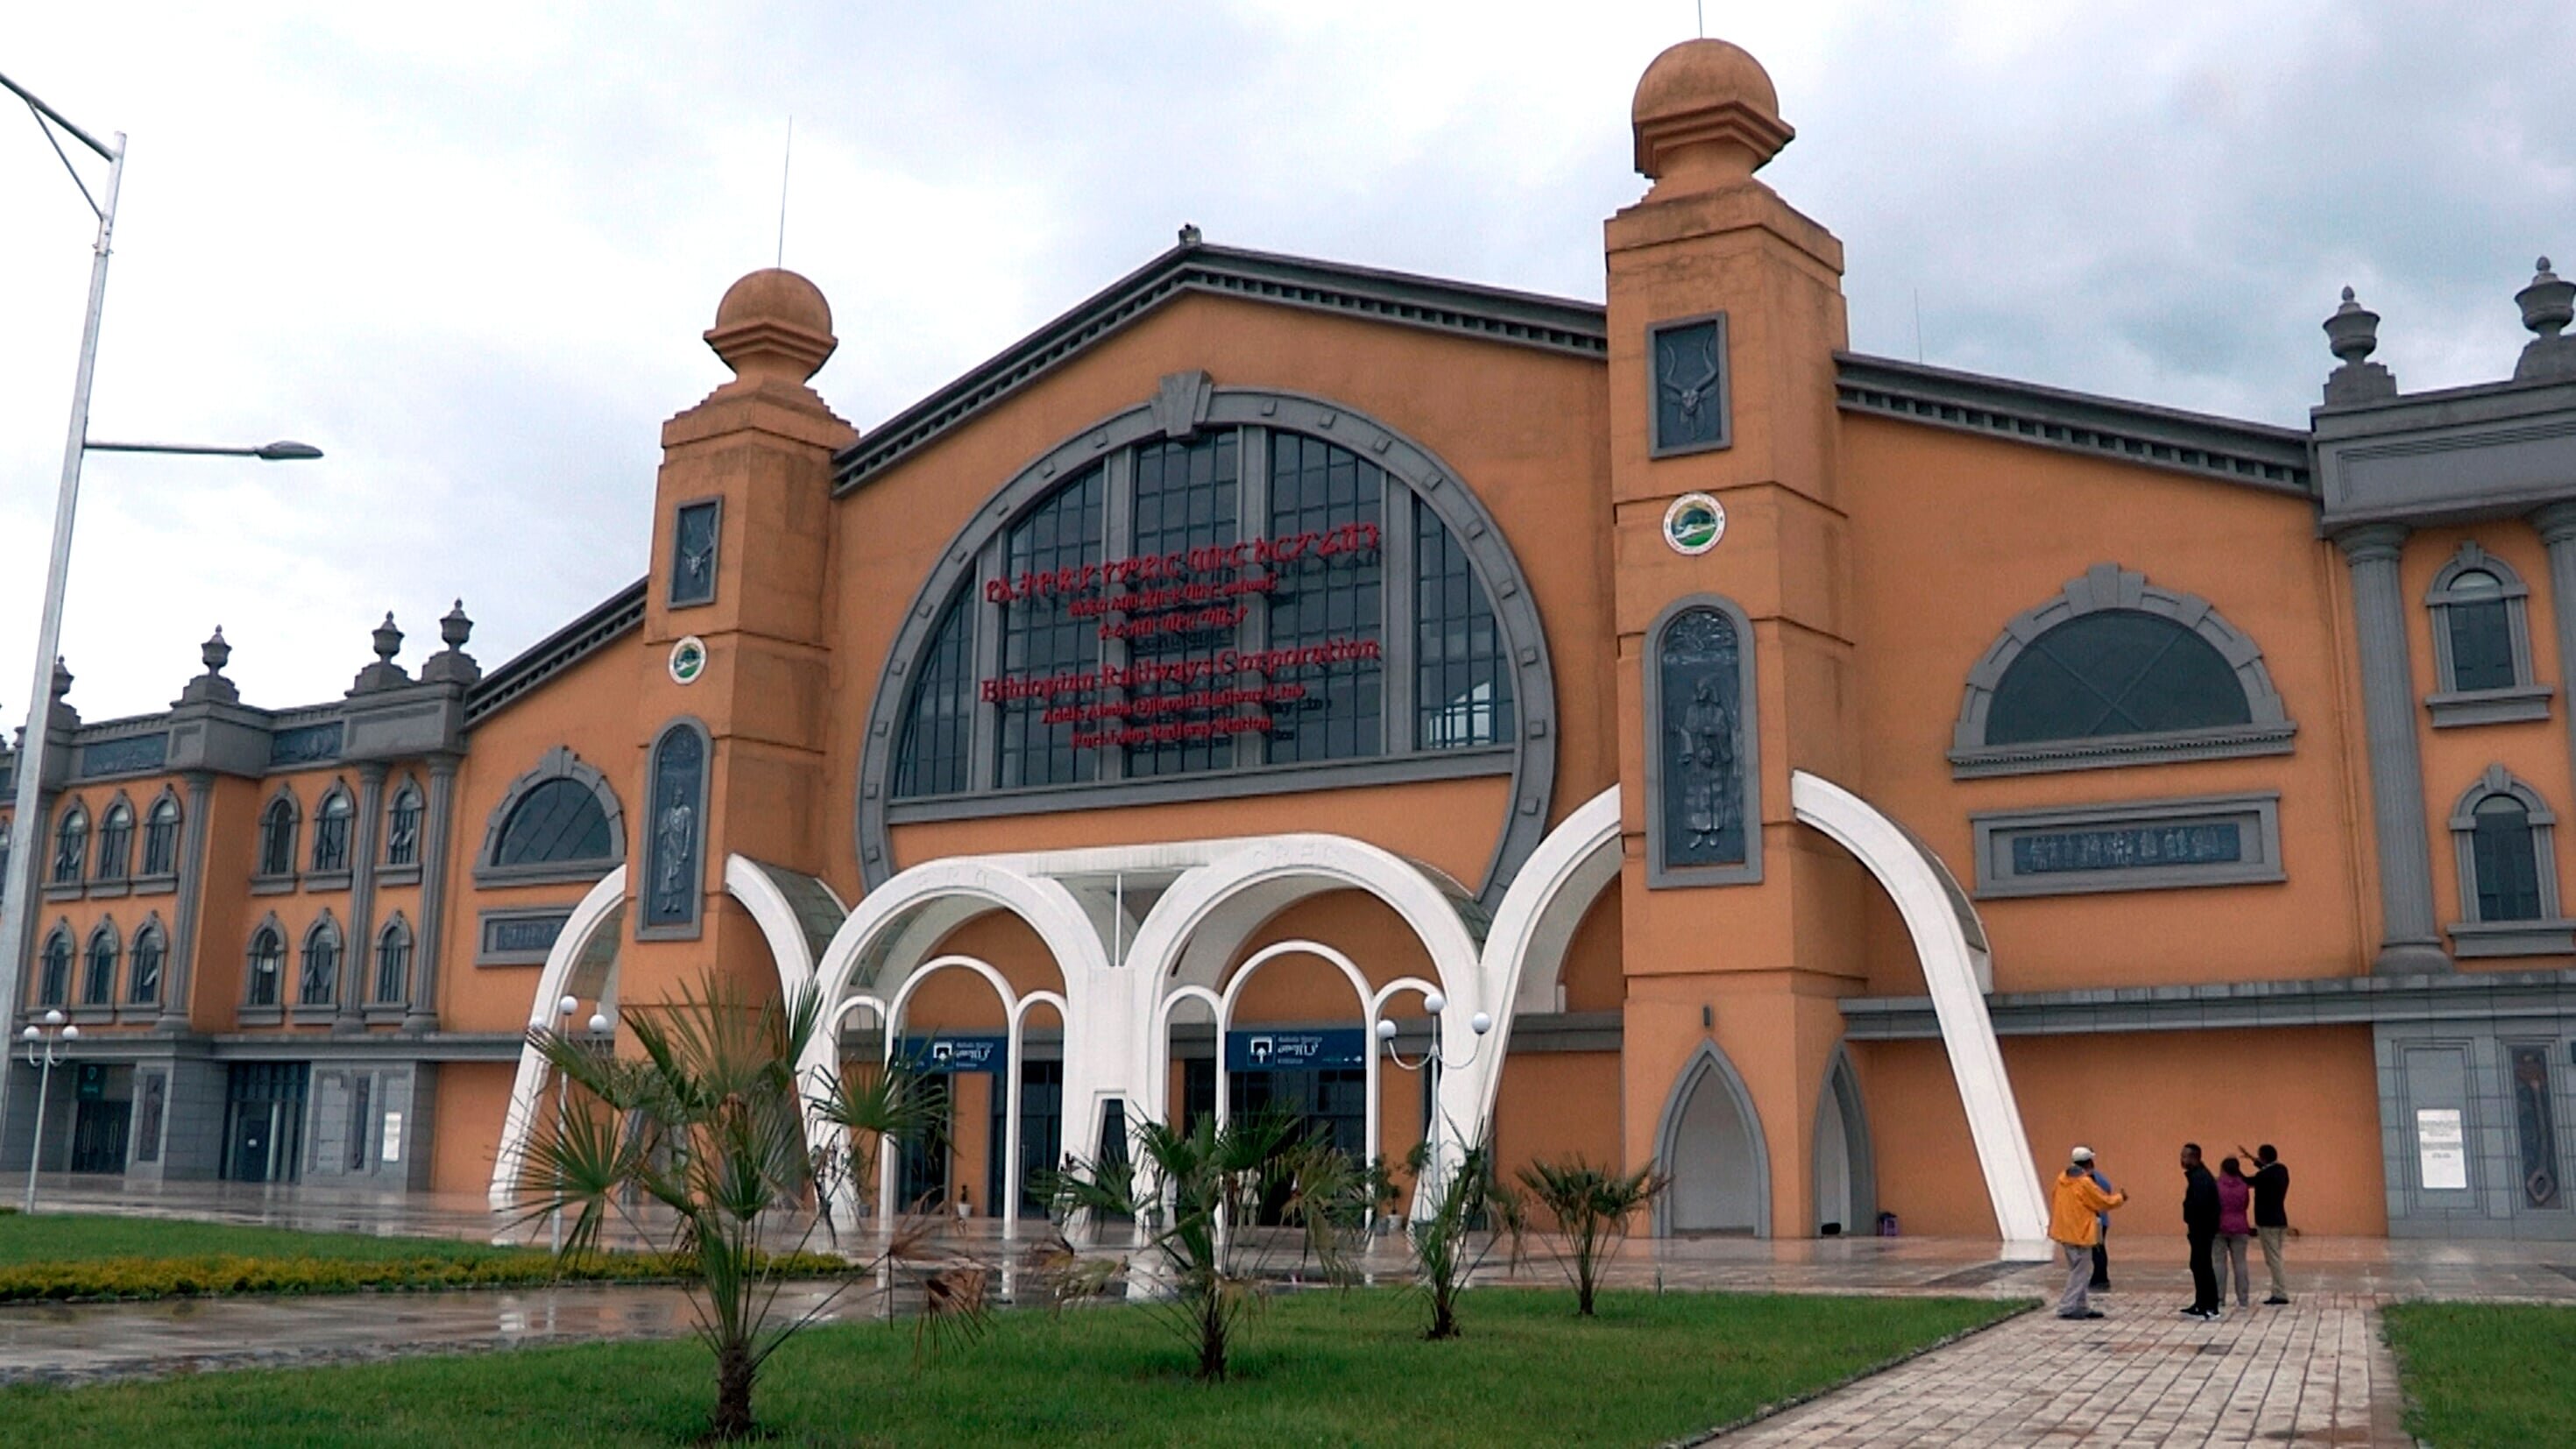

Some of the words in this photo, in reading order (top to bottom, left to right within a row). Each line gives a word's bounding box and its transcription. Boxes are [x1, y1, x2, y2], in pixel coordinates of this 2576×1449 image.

[980, 673, 1095, 702] Ethiopian
[1101, 660, 1214, 689] Railways
[1217, 638, 1380, 676] Corporation
